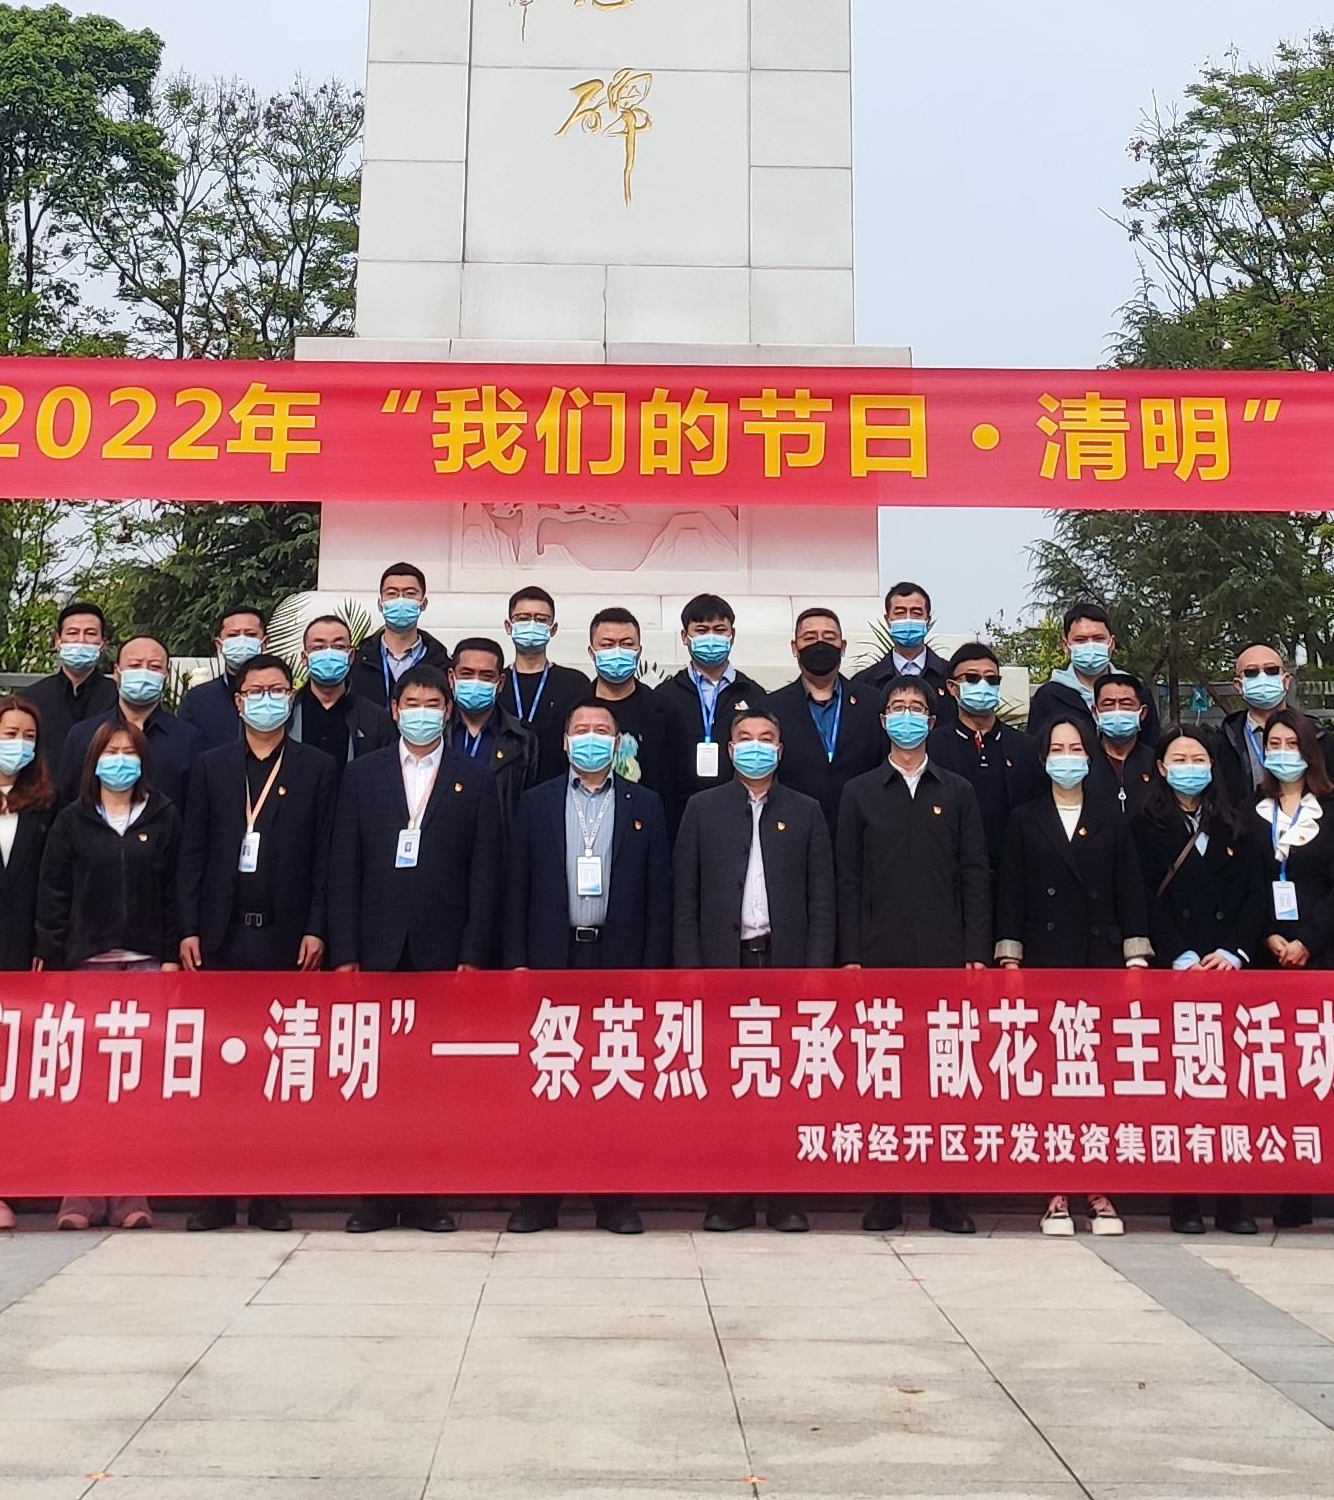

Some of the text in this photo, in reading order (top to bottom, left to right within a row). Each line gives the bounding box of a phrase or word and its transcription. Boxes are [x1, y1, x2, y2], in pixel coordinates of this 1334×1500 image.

[729, 997, 905, 1101] 亮承诺
[796, 1122, 1323, 1166] 双桥经开区开发投资集团有限公司
